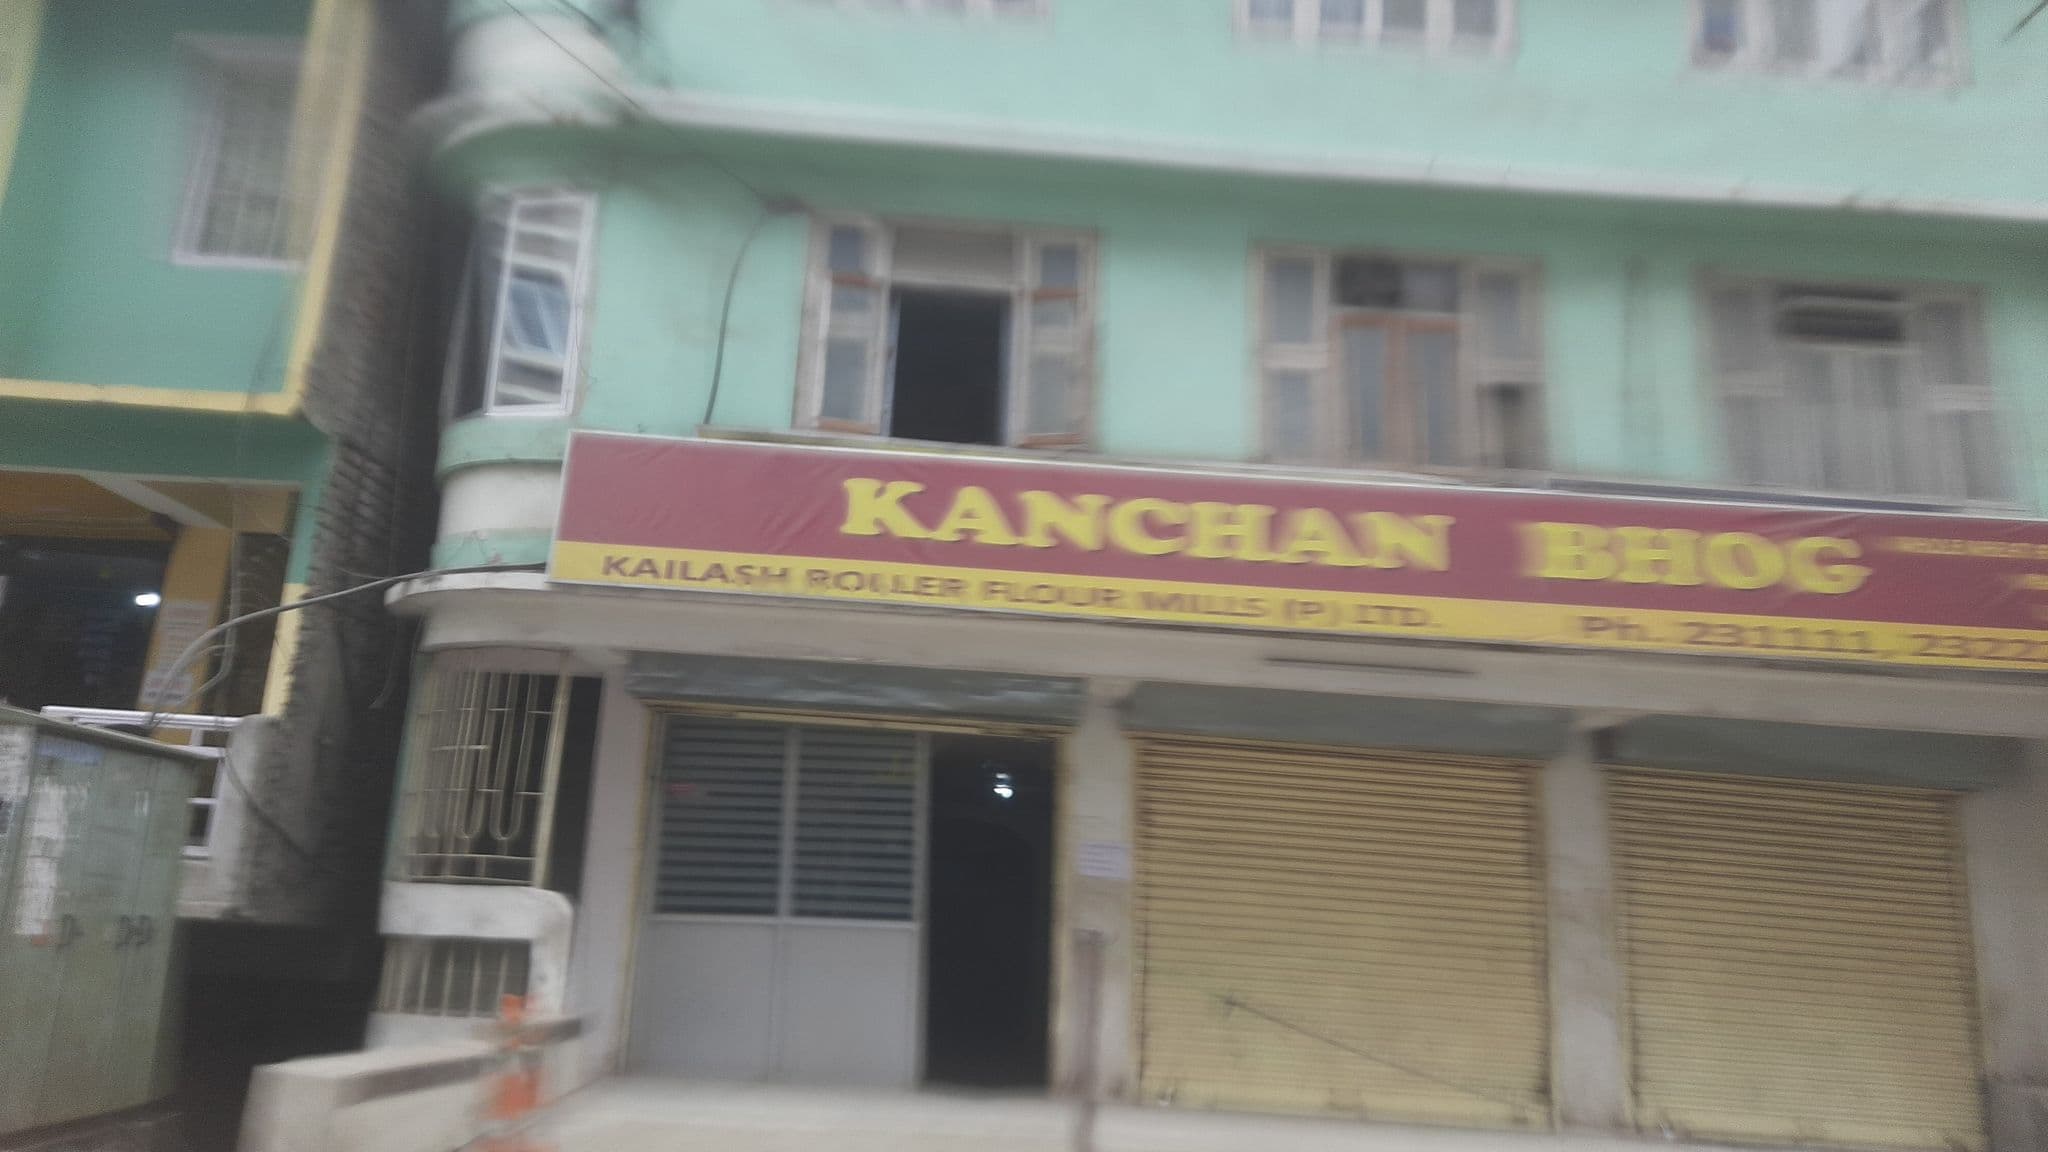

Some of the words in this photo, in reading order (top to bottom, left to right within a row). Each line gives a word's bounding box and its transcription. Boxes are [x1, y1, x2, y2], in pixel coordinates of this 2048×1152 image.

[841, 478, 1456, 571] KANCHAN
[1524, 522, 1872, 594] BHOG
[601, 555, 787, 584] KAILASH
[806, 569, 968, 597] ROLLER
[984, 581, 1124, 607] FLOUR
[1136, 590, 1267, 617] MILLS
[1283, 599, 1342, 626] (P)
[1352, 604, 1442, 627] LTD.
